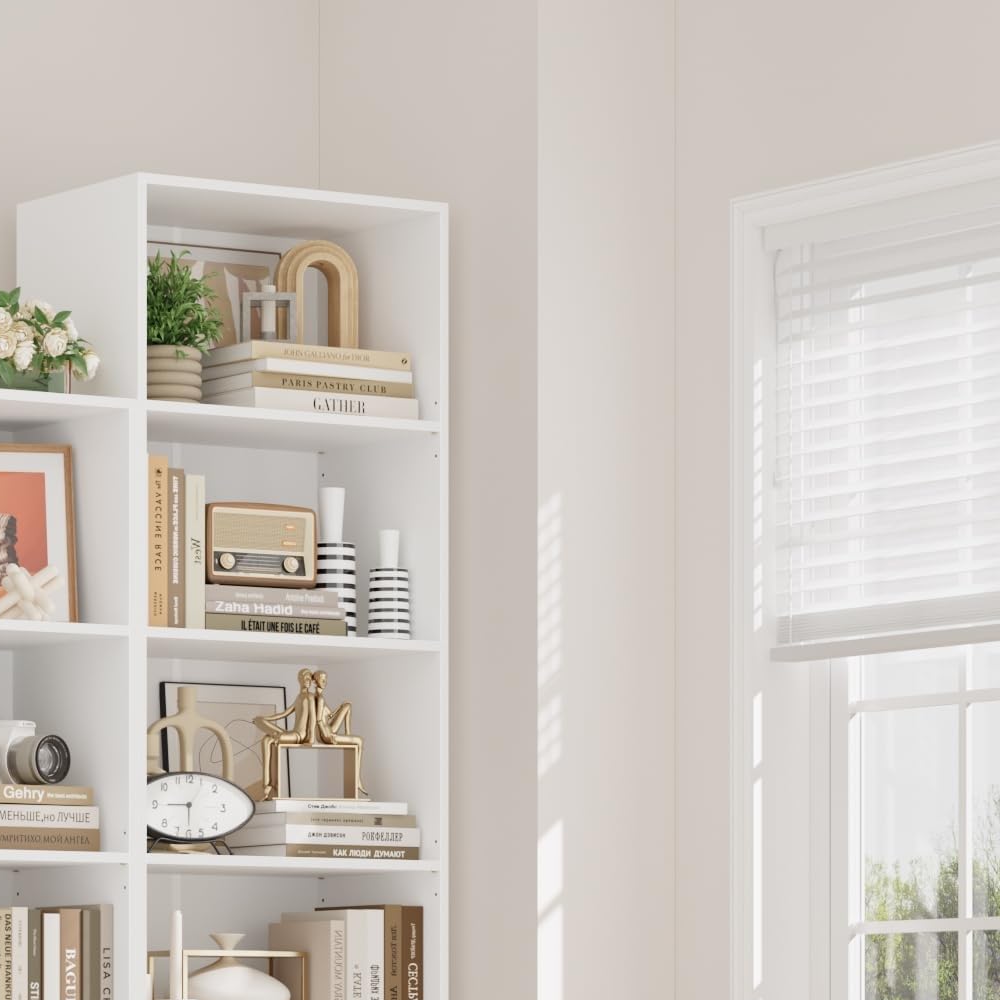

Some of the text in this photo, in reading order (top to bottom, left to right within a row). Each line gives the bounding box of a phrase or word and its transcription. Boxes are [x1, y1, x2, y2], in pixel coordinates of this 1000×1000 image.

[282, 378, 388, 394] PARIS PASTRY CLUB
[313, 398, 366, 414] GATHER
[215, 600, 250, 613] Zaha
[254, 603, 293, 615] Hadid
[241, 618, 320, 634] IL ÉTAIT UNE FOIS LE CAFÉ
[185, 775, 194, 784] 12
[160, 783, 168, 792] 10
[211, 784, 218, 793] 2
[3, 785, 44, 802] Gehry
[152, 800, 158, 809] 9
[220, 803, 226, 813] 3
[57, 812, 91, 823] ЛУЧШЕ
[161, 818, 168, 828] 8
[211, 821, 218, 831] 4
[64, 836, 90, 845] АНГЕЛ
[362, 831, 403, 842] РОКФЕЛЛЕР
[333, 848, 347, 857] КАК
[349, 849, 371, 858] ЛЮДИ
[373, 850, 405, 859] ДУМАЮТ
[4, 913, 12, 931] DAS
[4, 934, 12, 958] NEUE
[102, 947, 110, 979] LISA
